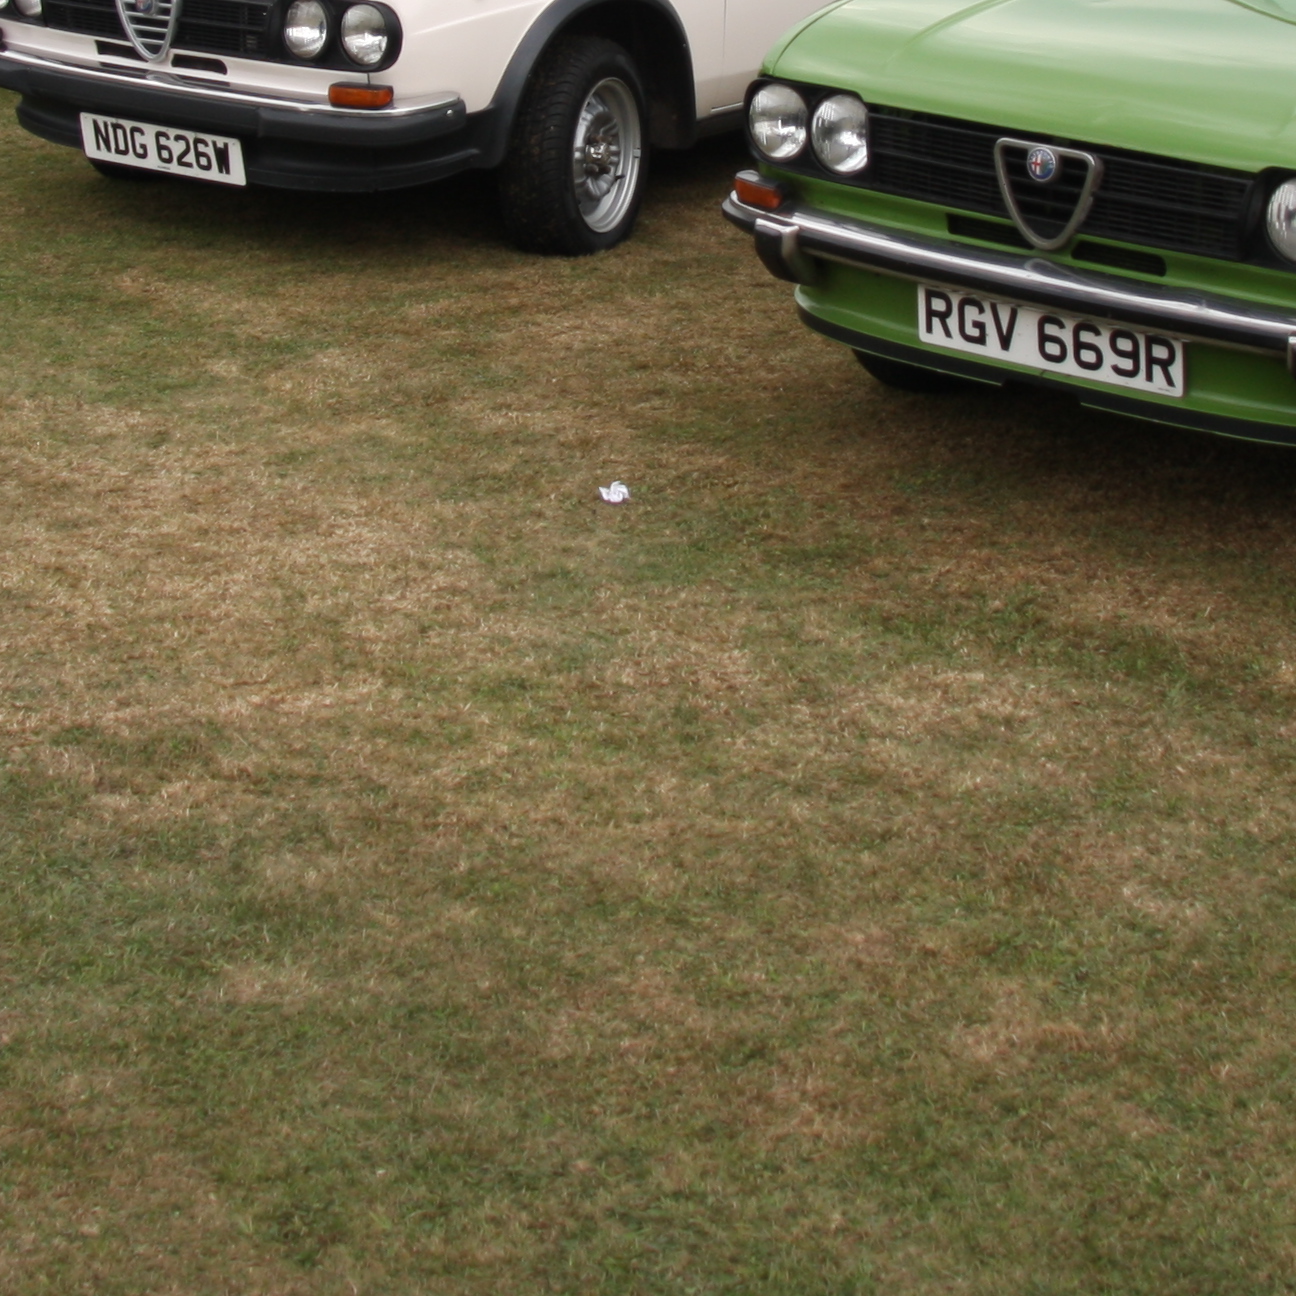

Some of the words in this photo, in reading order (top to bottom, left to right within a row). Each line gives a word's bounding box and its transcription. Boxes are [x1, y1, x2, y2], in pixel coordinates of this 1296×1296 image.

[92, 118, 148, 159] NDG
[155, 130, 230, 175] 626W
[924, 288, 1018, 352] RGV
[1037, 314, 1177, 388] 669R
